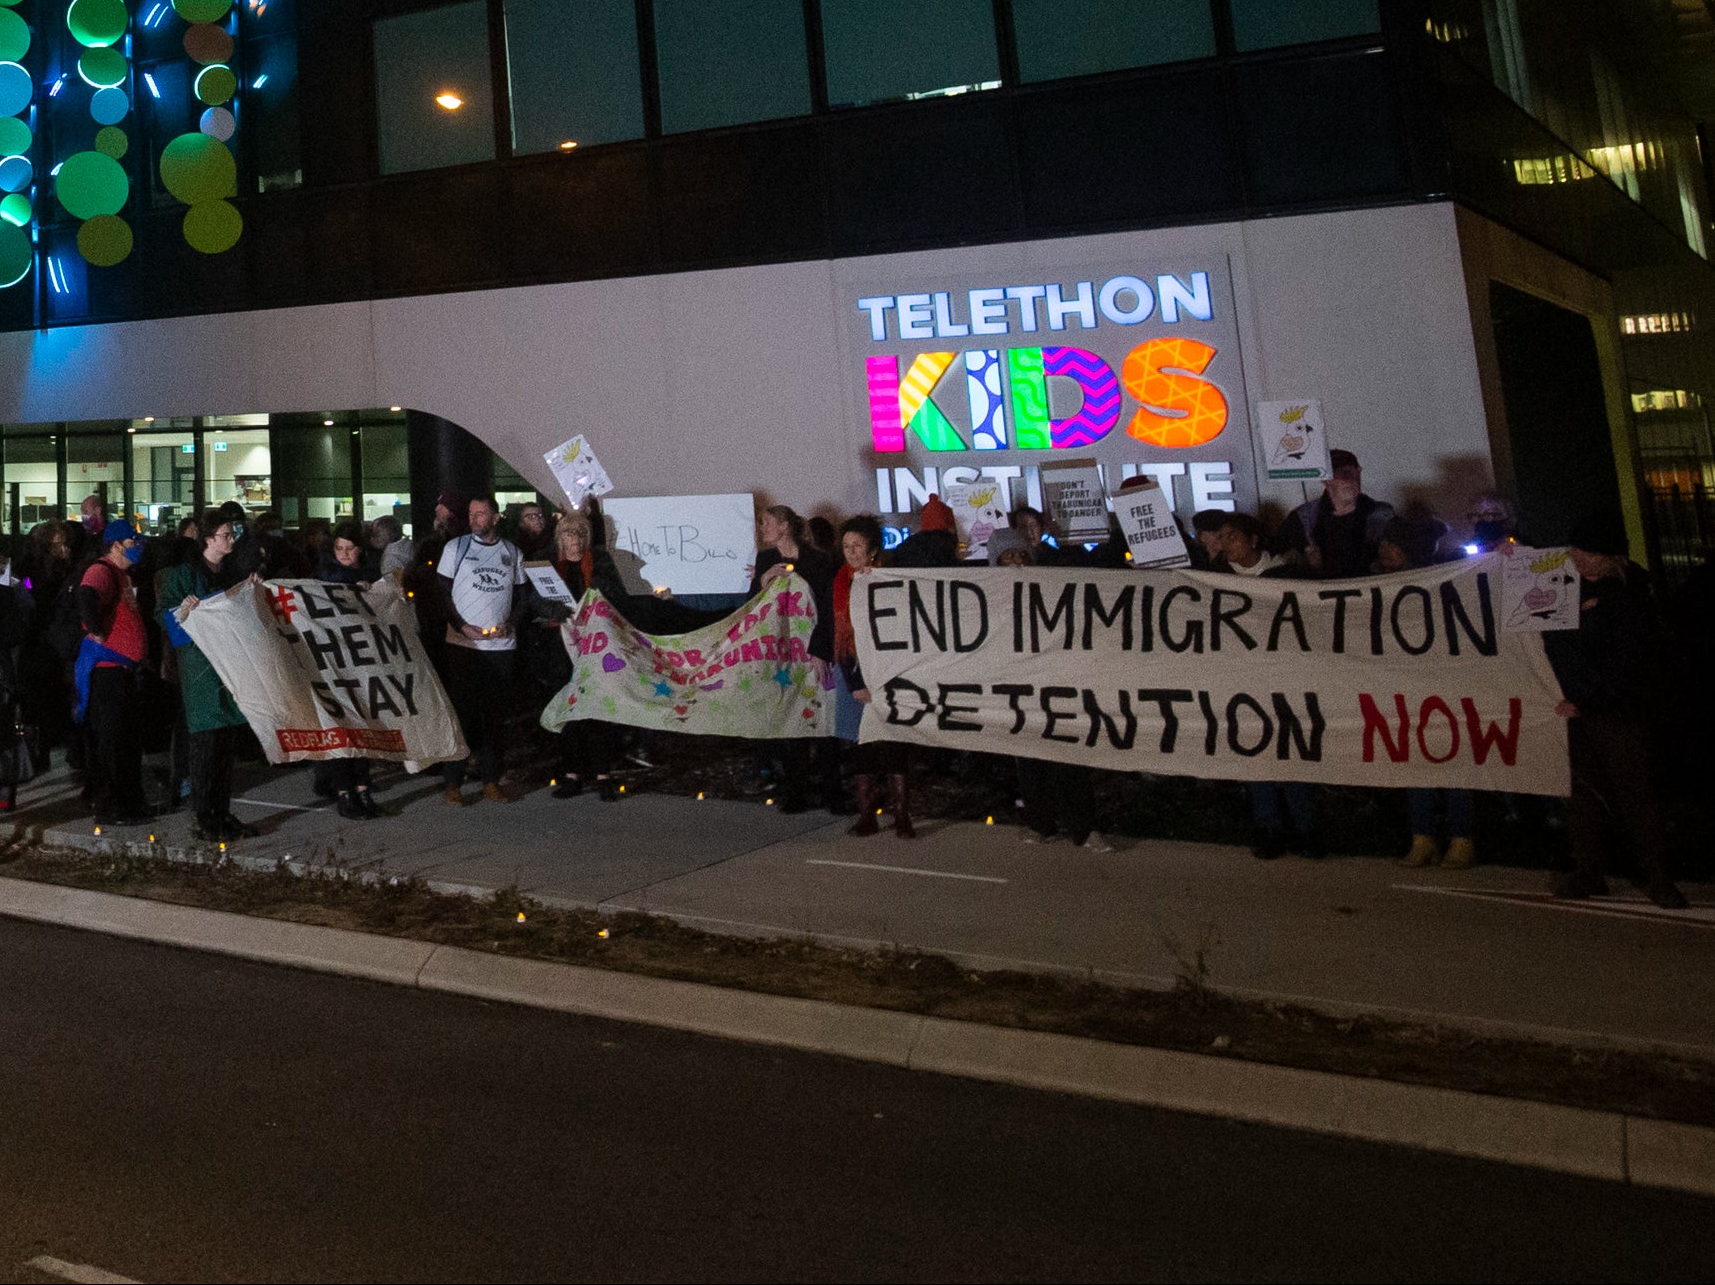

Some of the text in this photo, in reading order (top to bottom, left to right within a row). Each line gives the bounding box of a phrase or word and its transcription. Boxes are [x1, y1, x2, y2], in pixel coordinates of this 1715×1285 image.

[857, 271, 1213, 342] TELETHON
[865, 337, 1229, 453] KIDS
[1059, 489, 1090, 499] DEPORT
[1130, 503, 1154, 518] FREE
[1127, 526, 1177, 546] REFUGEES
[1138, 517, 1157, 530] THE
[472, 582, 505, 593] WELCOME
[868, 579, 989, 654] END
[1012, 572, 1498, 657] IMMIGRATION
[310, 673, 419, 720] STAY
[884, 676, 1522, 766] DETENTION NOW
